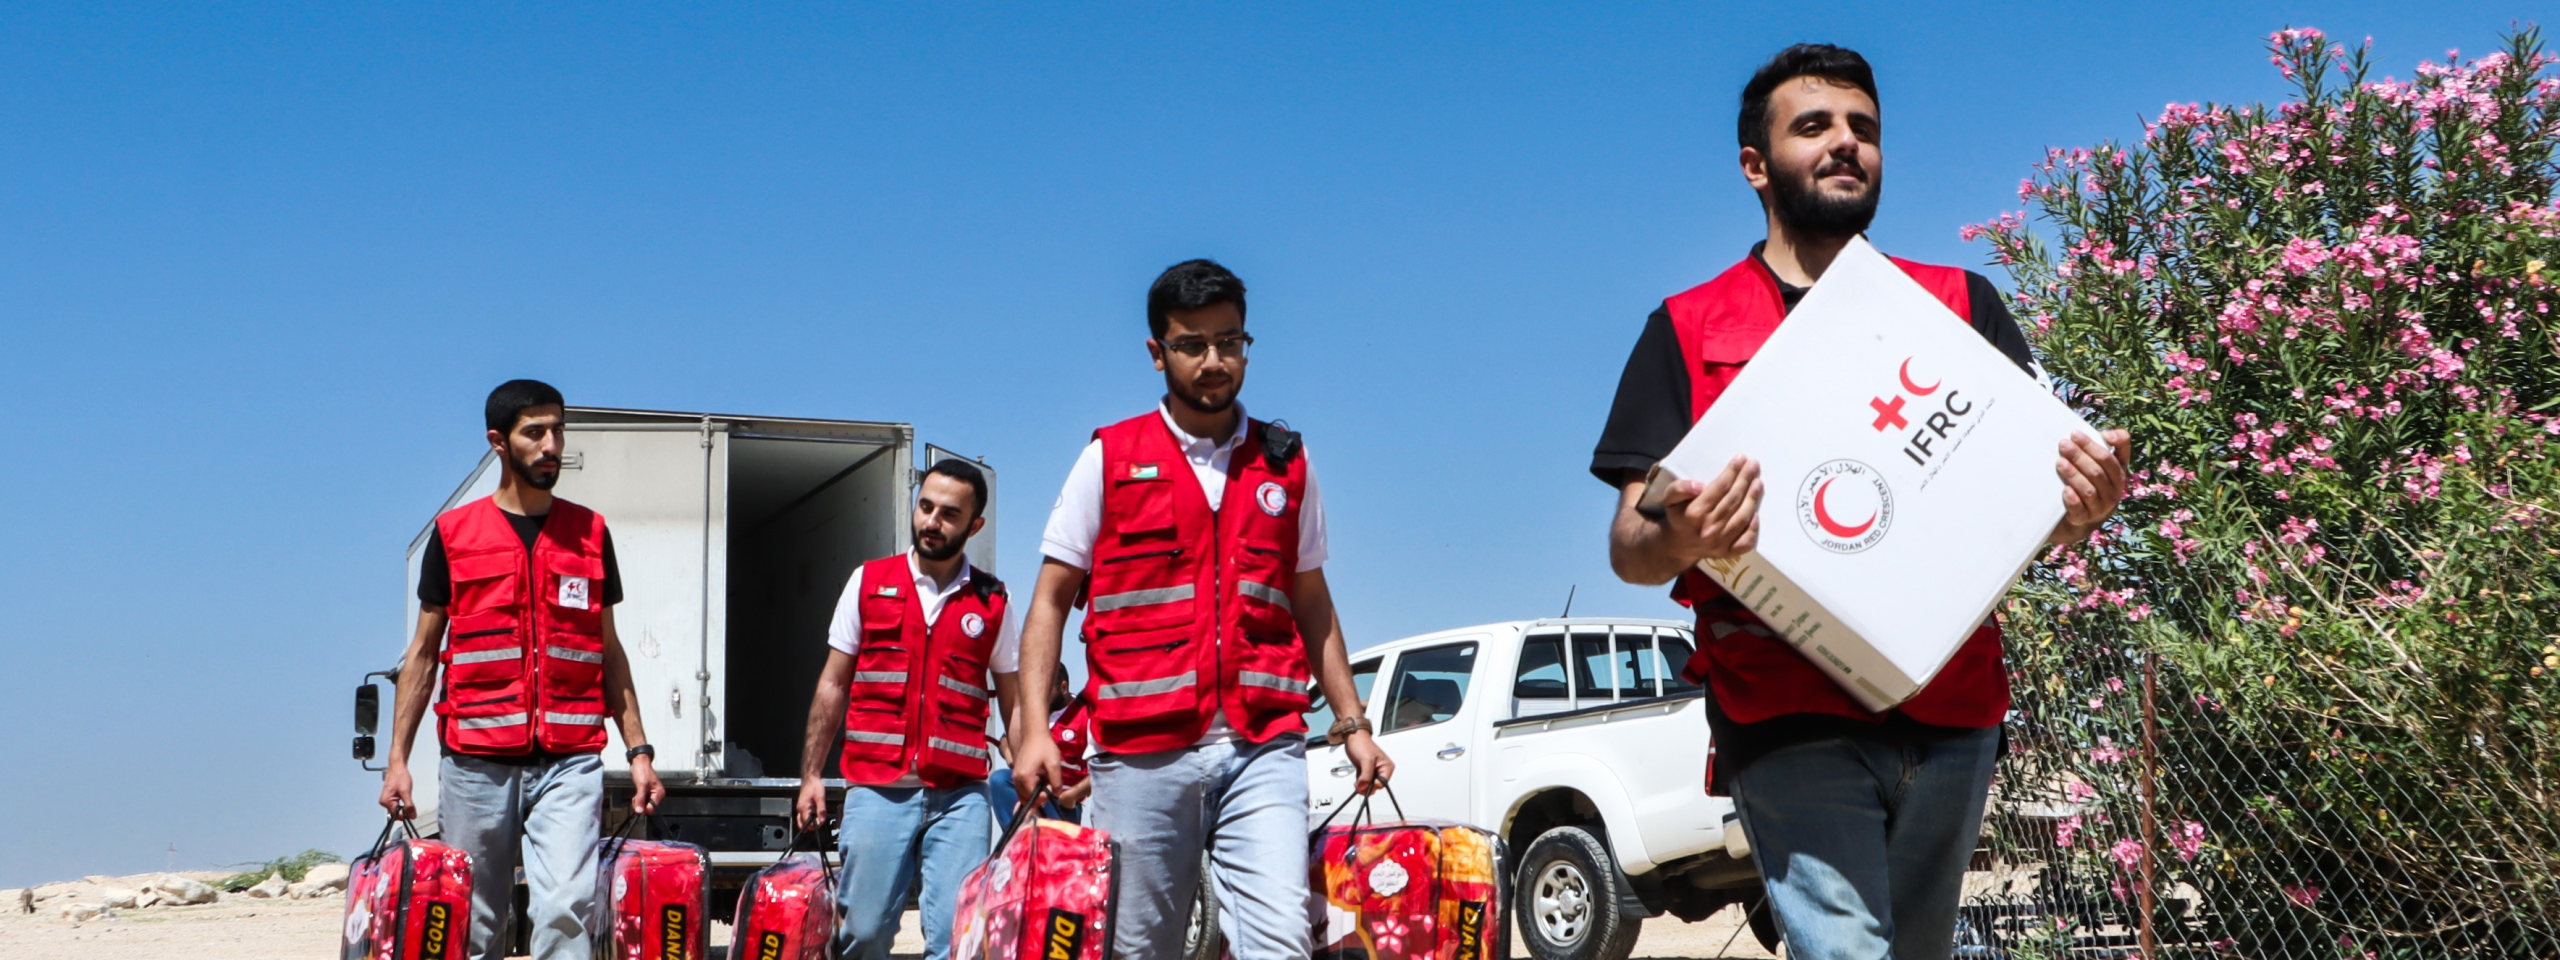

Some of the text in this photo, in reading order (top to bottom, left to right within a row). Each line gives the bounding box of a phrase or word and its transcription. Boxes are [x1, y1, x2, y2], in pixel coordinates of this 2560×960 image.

[1903, 390, 1972, 467] IFRC
[1836, 462, 1866, 476] الهلال
[1821, 478, 1890, 551] JORDAN RED CRESCENT
[427, 905, 446, 955] GOLD
[1048, 915, 1076, 960] DIA
